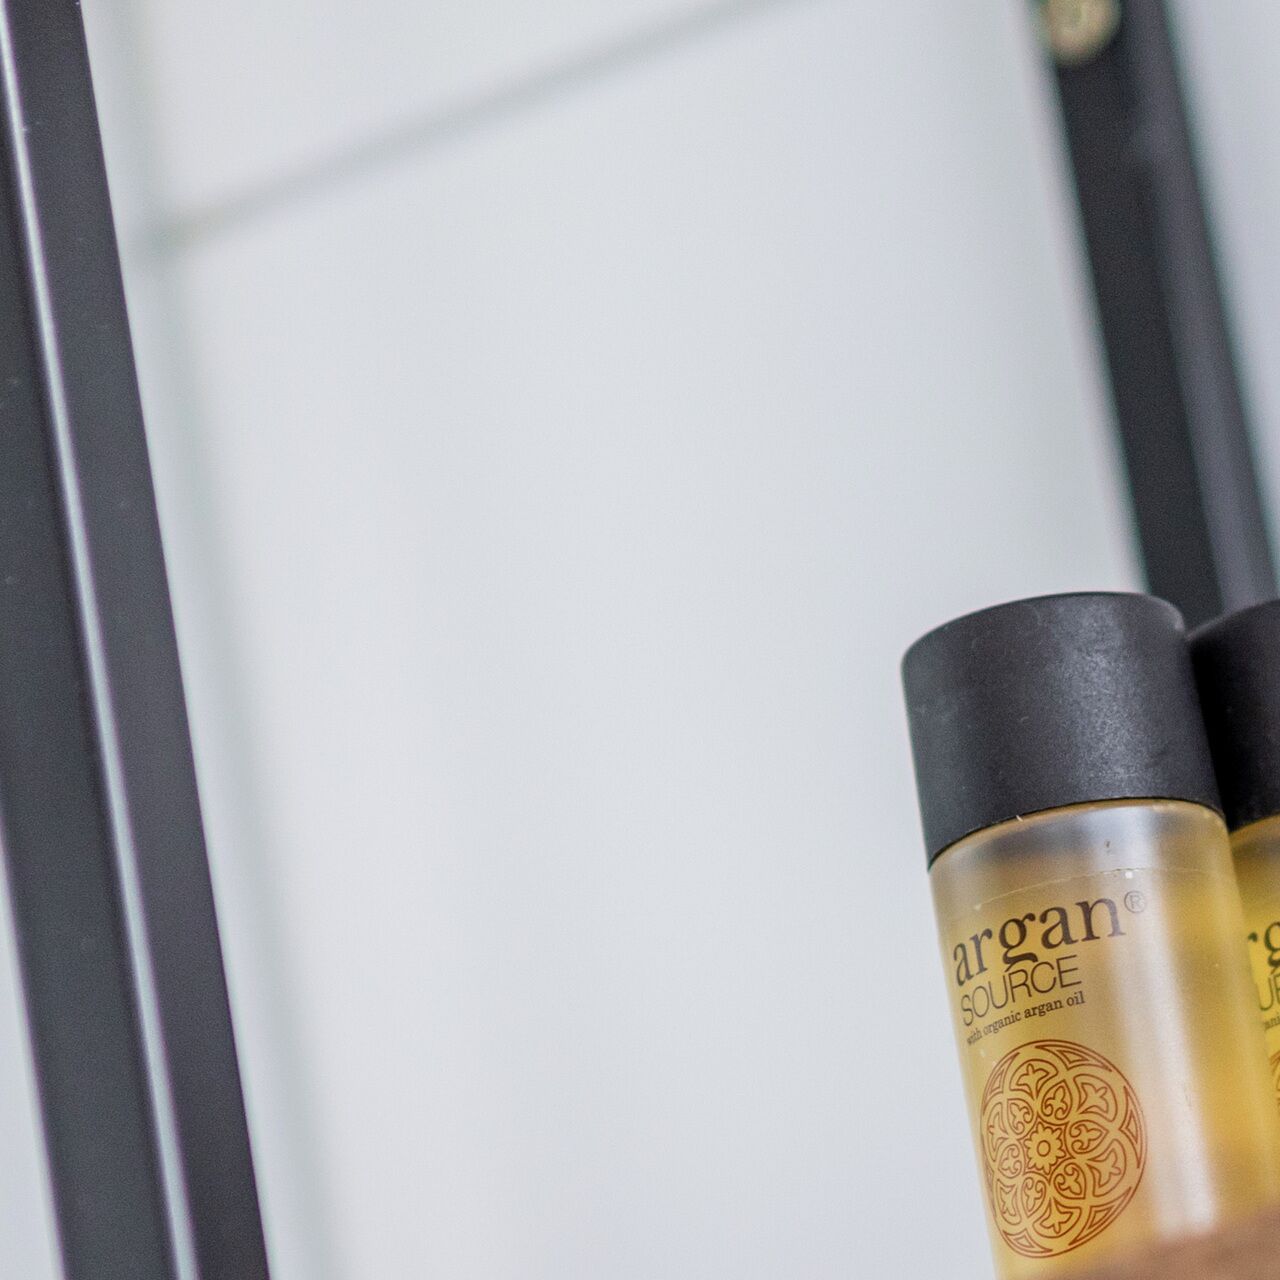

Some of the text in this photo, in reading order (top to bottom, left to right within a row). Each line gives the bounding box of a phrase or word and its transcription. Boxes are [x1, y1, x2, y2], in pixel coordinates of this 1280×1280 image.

[960, 954, 1082, 1027] SOURCE
[983, 1010, 1022, 1035] organic
[1023, 999, 1064, 1017] argan
[1066, 990, 1086, 1007] oil
